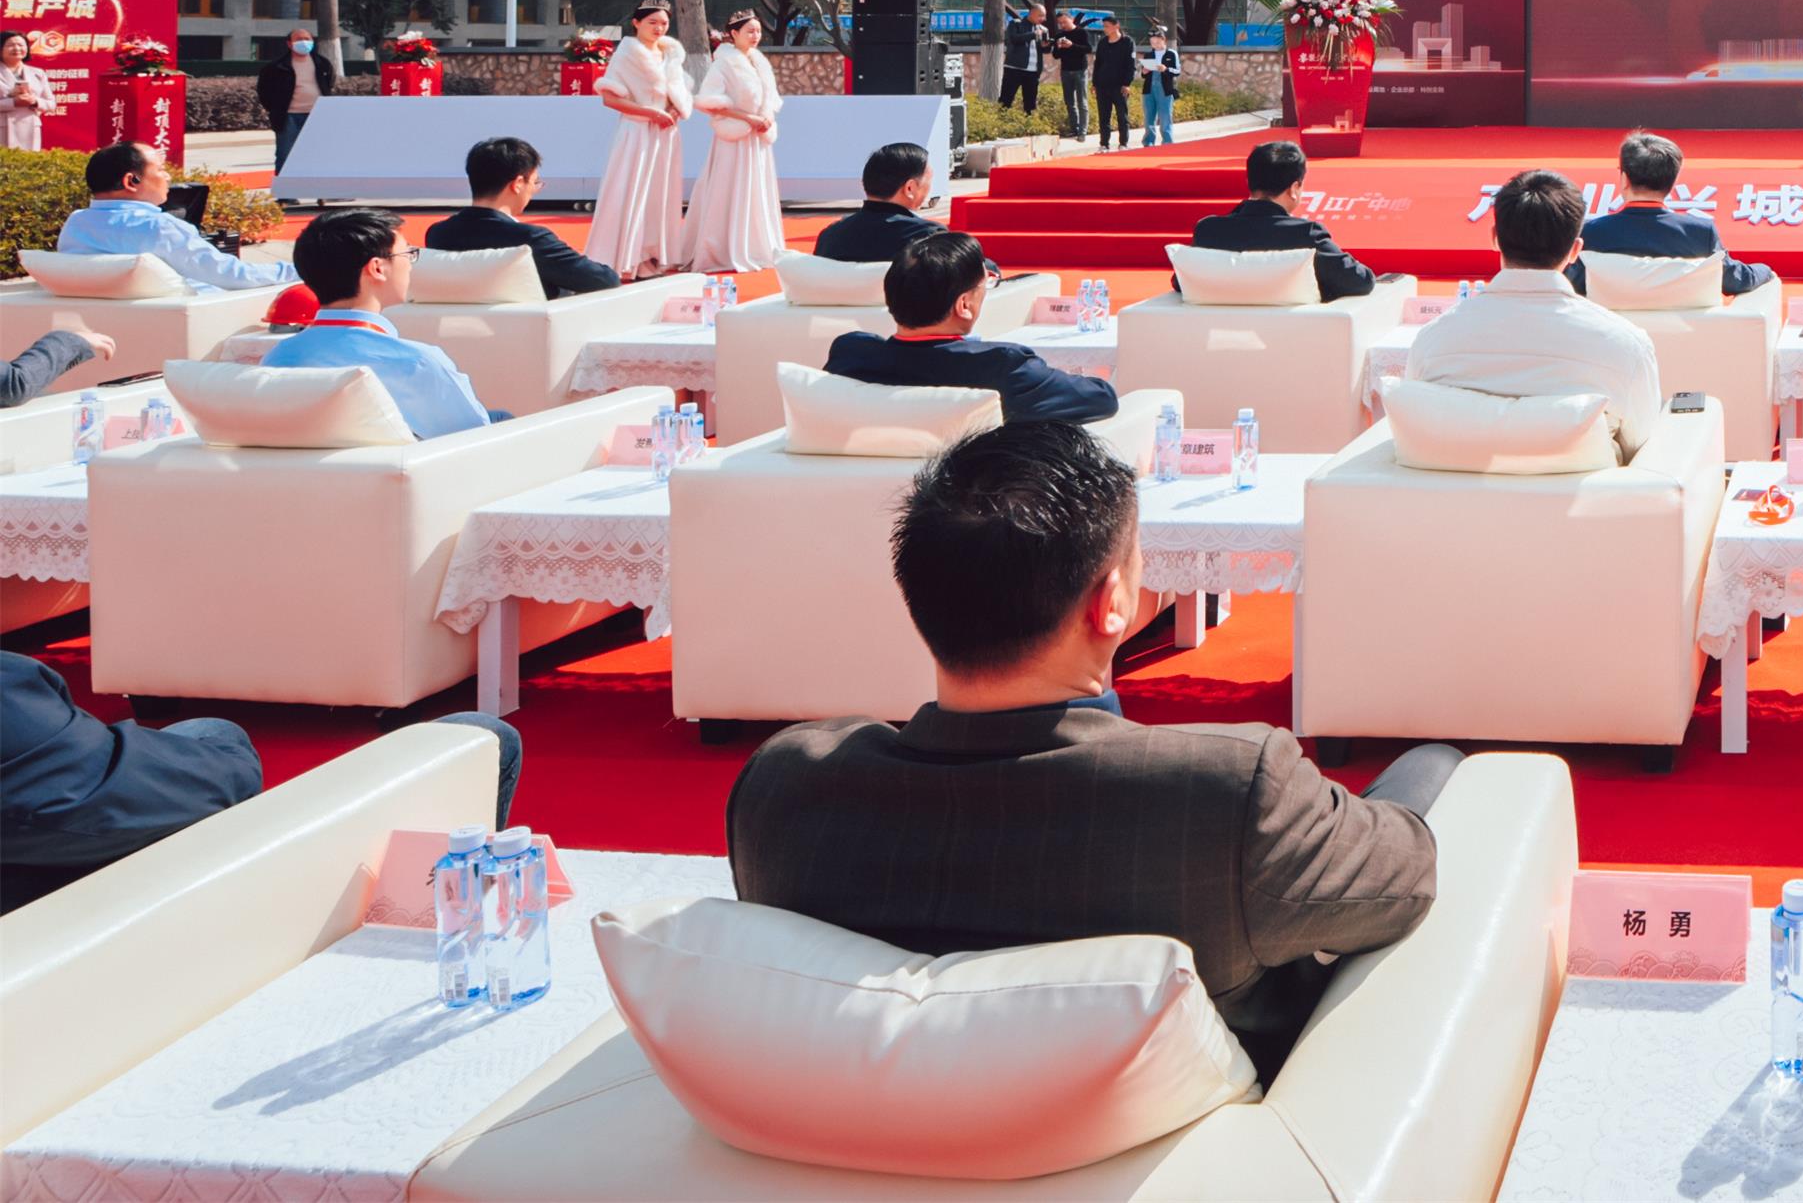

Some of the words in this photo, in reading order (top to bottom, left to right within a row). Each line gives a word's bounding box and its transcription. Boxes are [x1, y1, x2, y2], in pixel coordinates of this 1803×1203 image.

[110, 98, 126, 145] 封顶大
[1622, 909, 1692, 938] 杨勇
